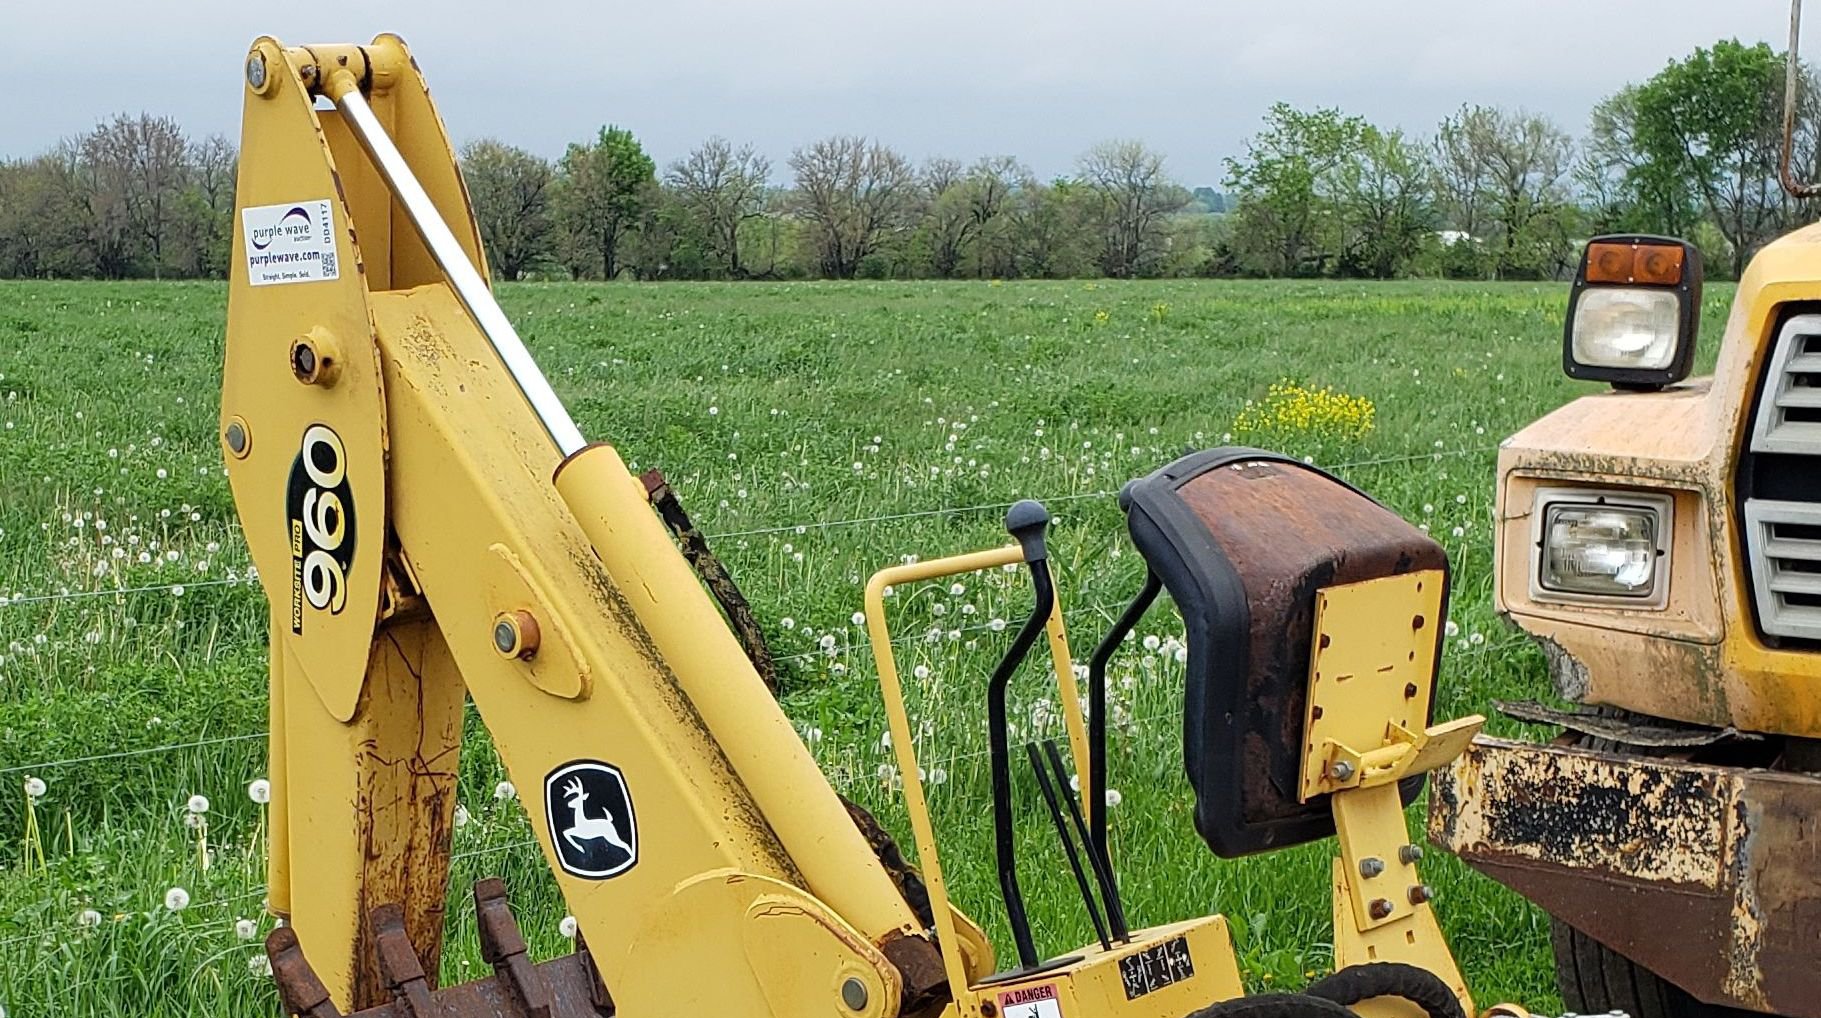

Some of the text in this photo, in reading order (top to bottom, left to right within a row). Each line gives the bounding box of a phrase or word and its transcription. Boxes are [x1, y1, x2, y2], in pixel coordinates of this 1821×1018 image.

[253, 224, 309, 239] purple wave
[250, 251, 320, 268] purplewave.com
[302, 423, 347, 615] 960
[293, 524, 302, 629] WORKSITE PRO
[1014, 985, 1053, 1004] DANGER
